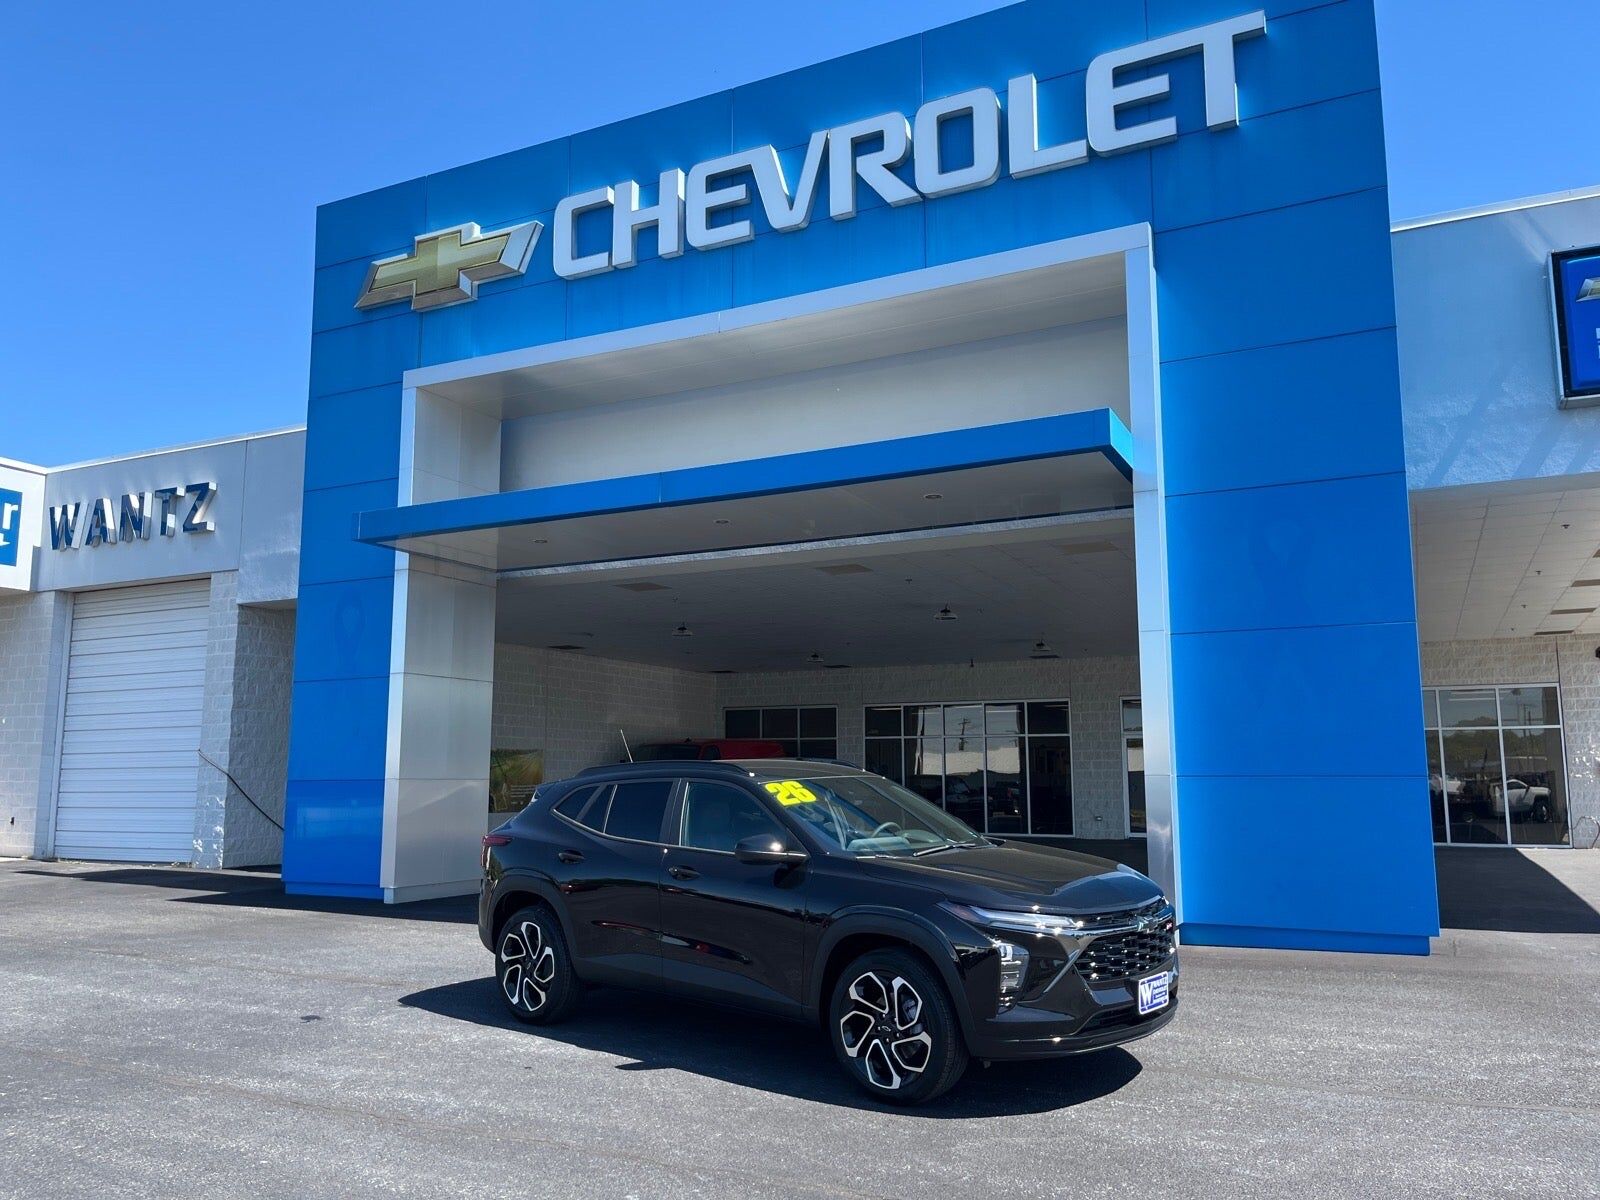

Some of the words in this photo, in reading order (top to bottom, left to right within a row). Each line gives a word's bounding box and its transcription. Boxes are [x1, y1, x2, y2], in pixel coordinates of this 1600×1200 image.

[553, 10, 1266, 280] CHEVROLET
[49, 482, 217, 551] WANTZ
[765, 780, 817, 806] 26
